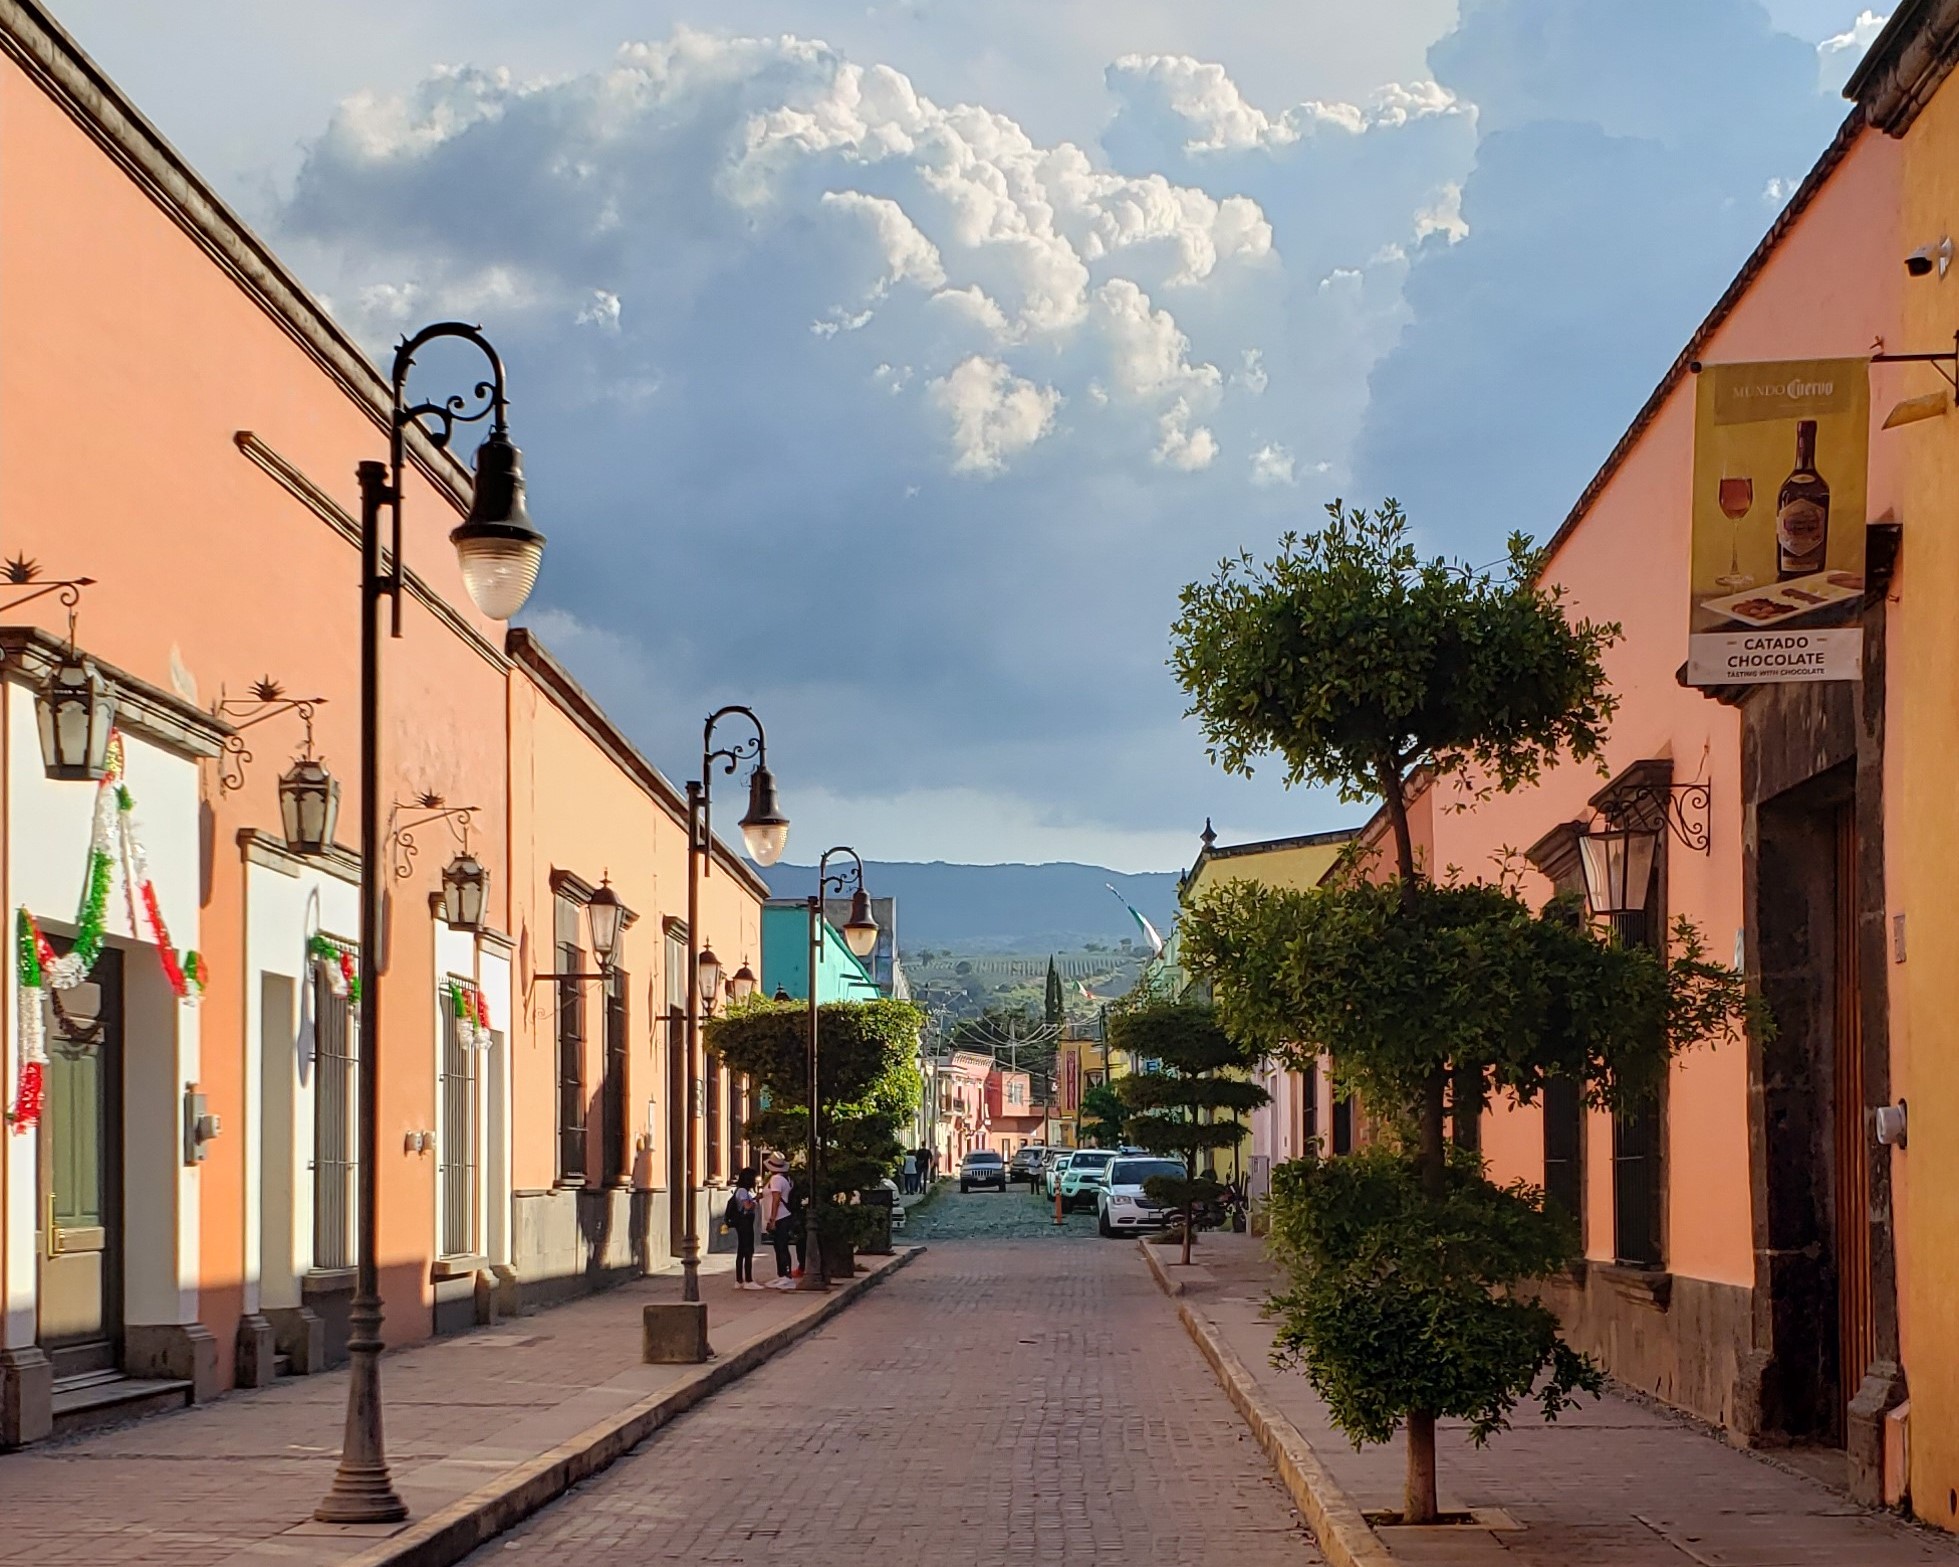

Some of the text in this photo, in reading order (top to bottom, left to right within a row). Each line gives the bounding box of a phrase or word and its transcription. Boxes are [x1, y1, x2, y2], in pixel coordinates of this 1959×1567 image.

[1786, 379, 1833, 399] Cuervo
[1744, 637, 1809, 650] CATADO
[1727, 653, 1825, 668] CHOCOLATE
[1780, 668, 1825, 676] CHOCOLATE
